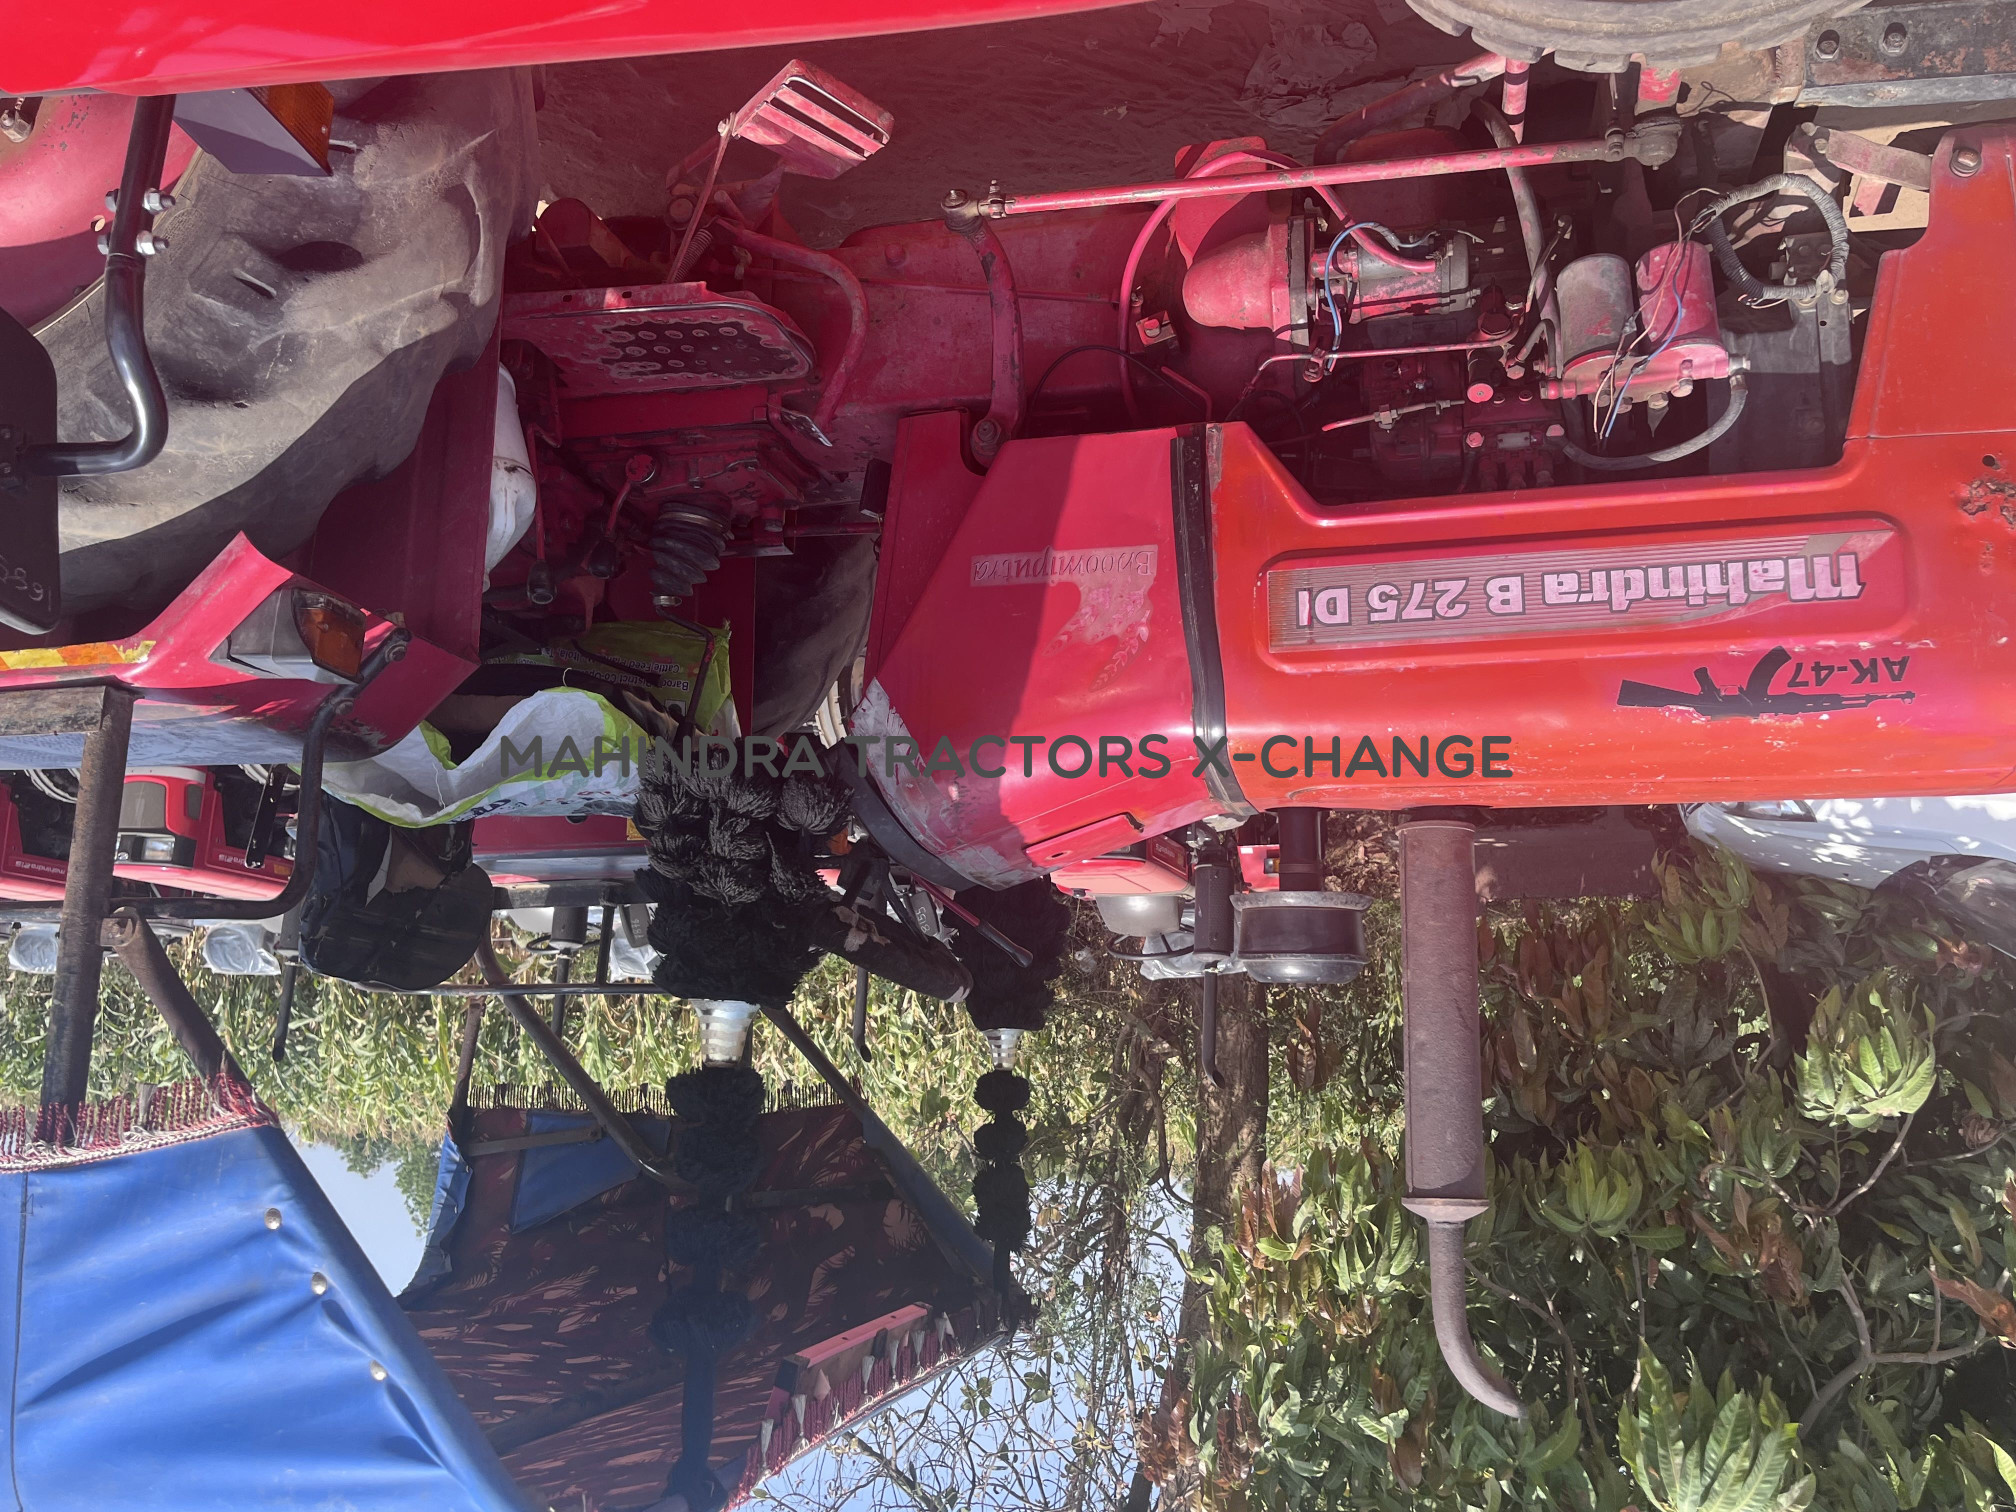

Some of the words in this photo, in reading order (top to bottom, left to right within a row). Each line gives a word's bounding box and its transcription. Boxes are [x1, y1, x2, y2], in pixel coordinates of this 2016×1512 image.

[1366, 577, 1469, 626] 275
[1484, 572, 1526, 618] B
[1540, 551, 1866, 614] Mahindra
[1294, 584, 1353, 631] DI
[628, 660, 651, 672] Feed
[652, 663, 680, 674] Cattle
[1786, 655, 1911, 688] AK-47
